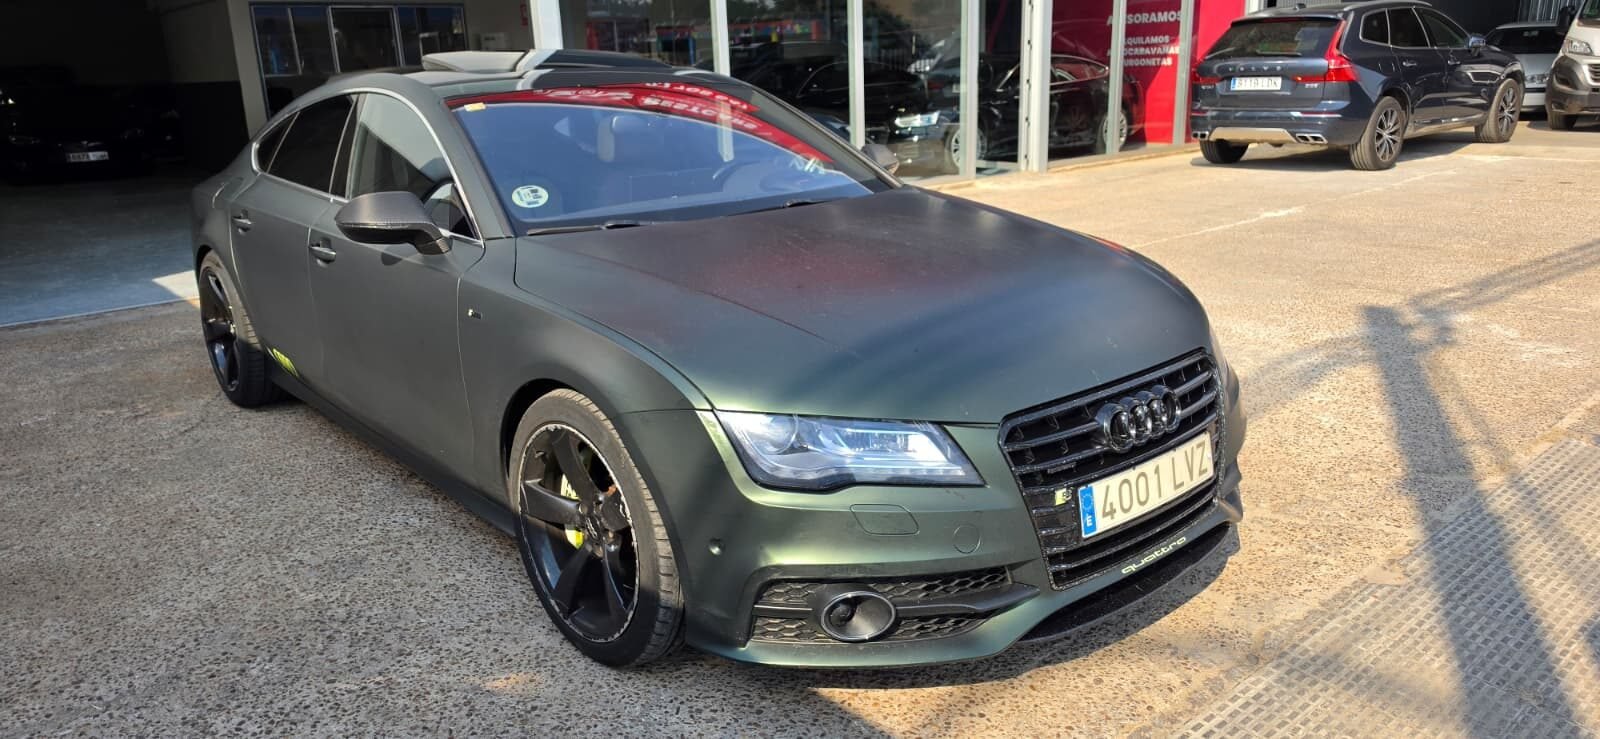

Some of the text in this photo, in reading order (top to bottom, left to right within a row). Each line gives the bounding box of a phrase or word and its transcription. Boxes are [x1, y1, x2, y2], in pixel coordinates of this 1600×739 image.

[1106, 10, 1183, 26] ASORAMOS
[1102, 441, 1208, 520] 4001 LVZ
[1086, 515, 1093, 527] E
[1121, 536, 1187, 575] quattro
